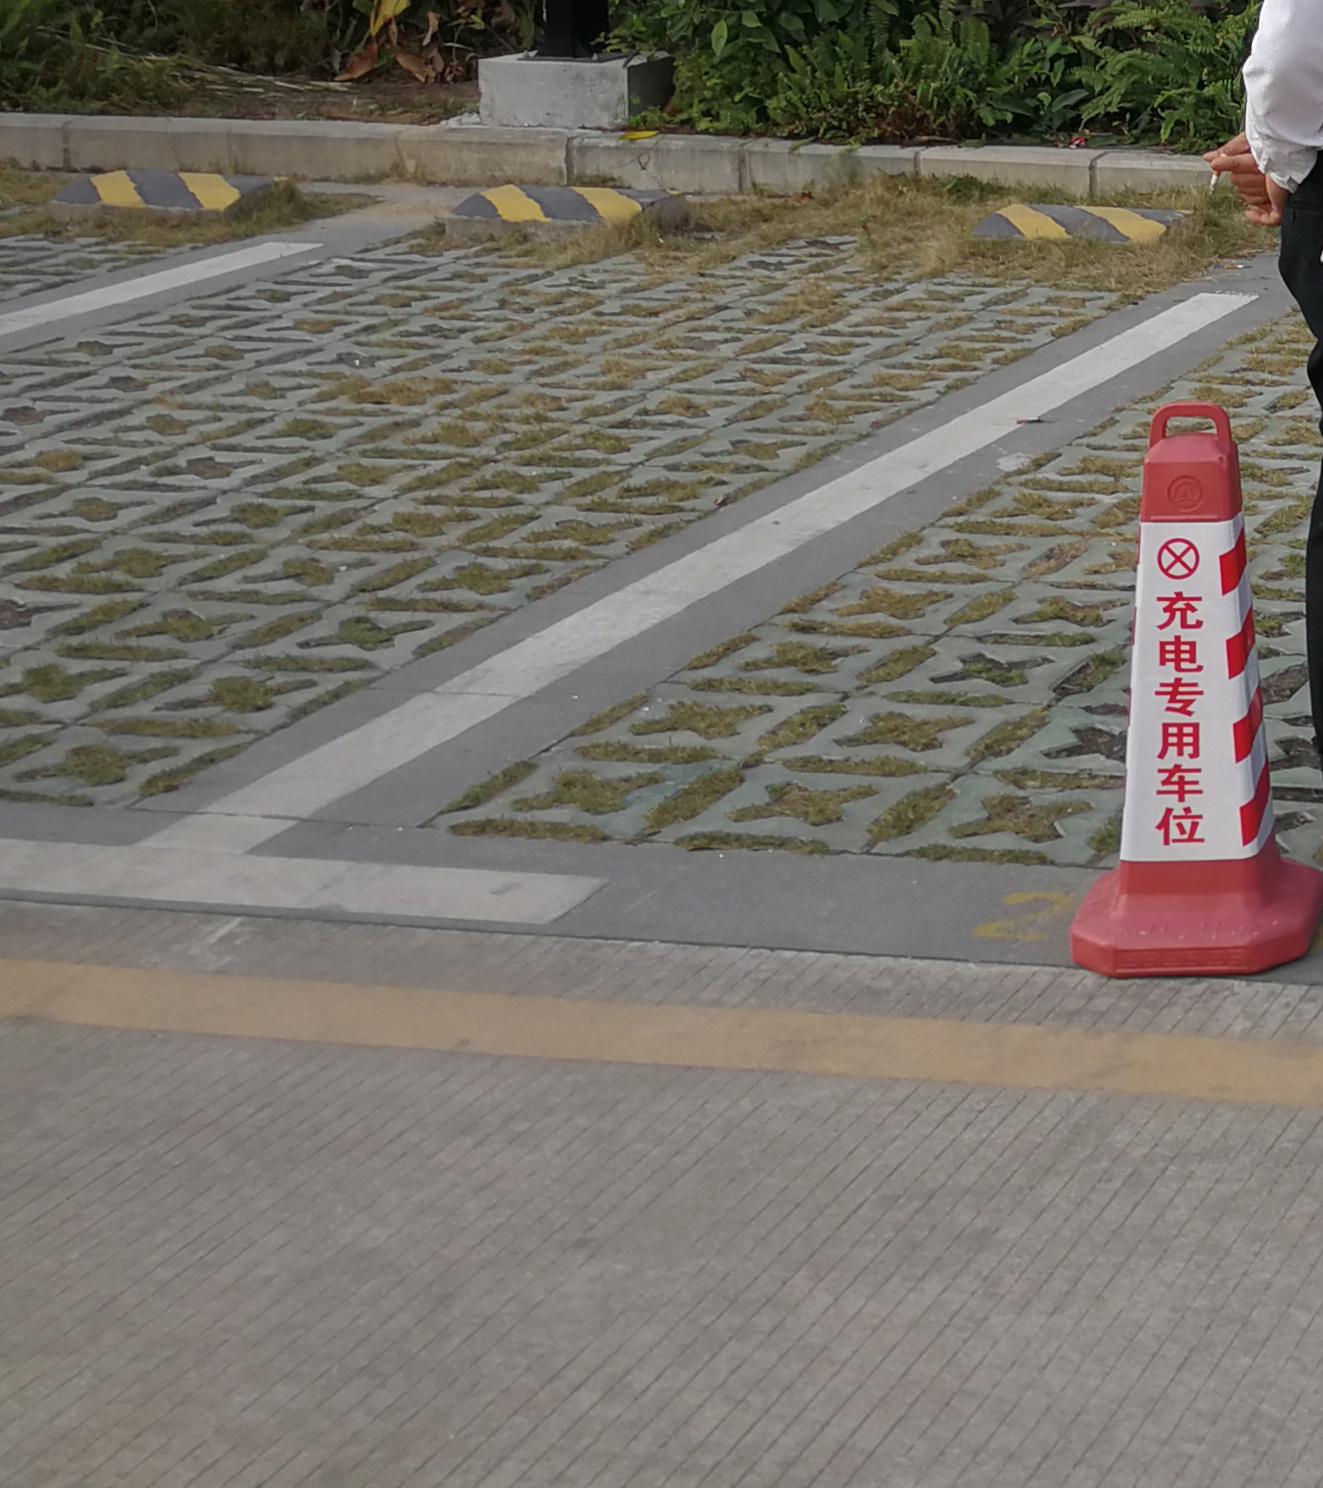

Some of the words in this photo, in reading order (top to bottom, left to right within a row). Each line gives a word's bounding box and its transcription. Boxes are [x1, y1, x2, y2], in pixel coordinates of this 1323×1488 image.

[1154, 591, 1206, 847] 充电专用车位
